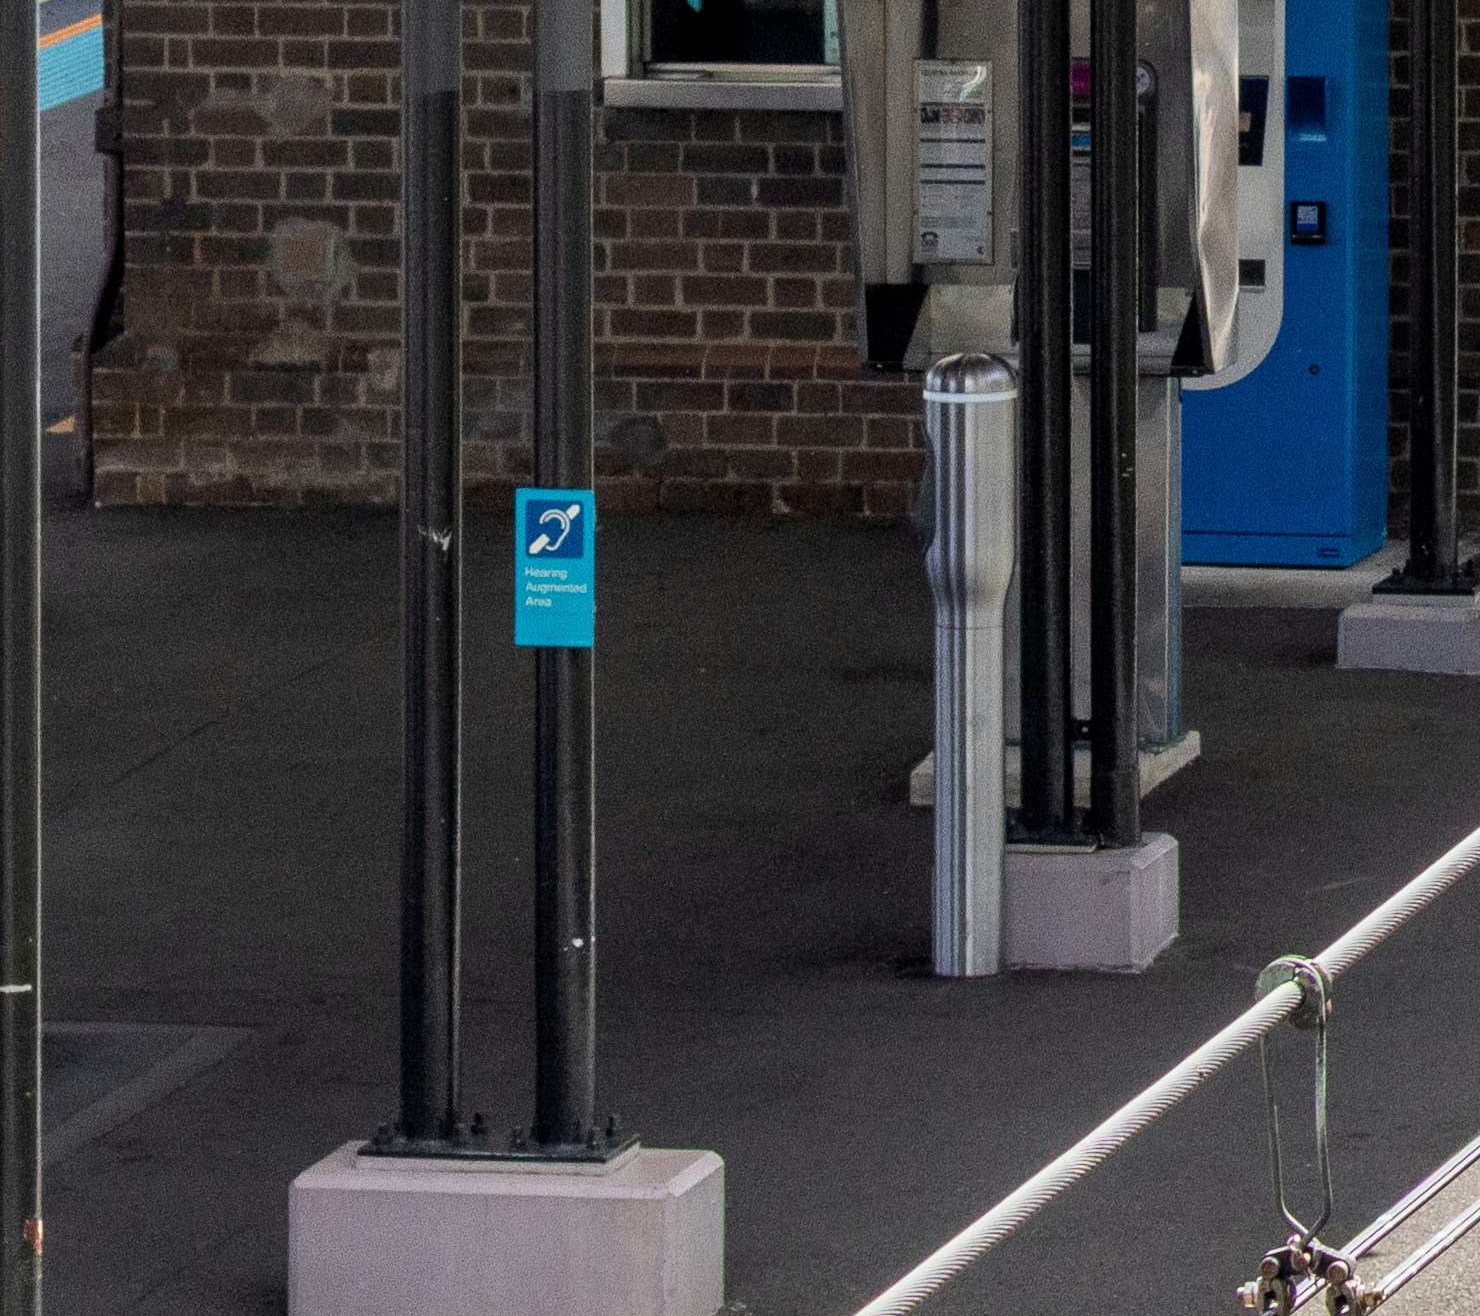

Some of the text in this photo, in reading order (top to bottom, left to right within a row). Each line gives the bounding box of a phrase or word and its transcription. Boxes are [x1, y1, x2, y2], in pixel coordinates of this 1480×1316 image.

[524, 567, 567, 581] Hearing
[526, 582, 587, 594] Augmented
[526, 597, 552, 607] Area
